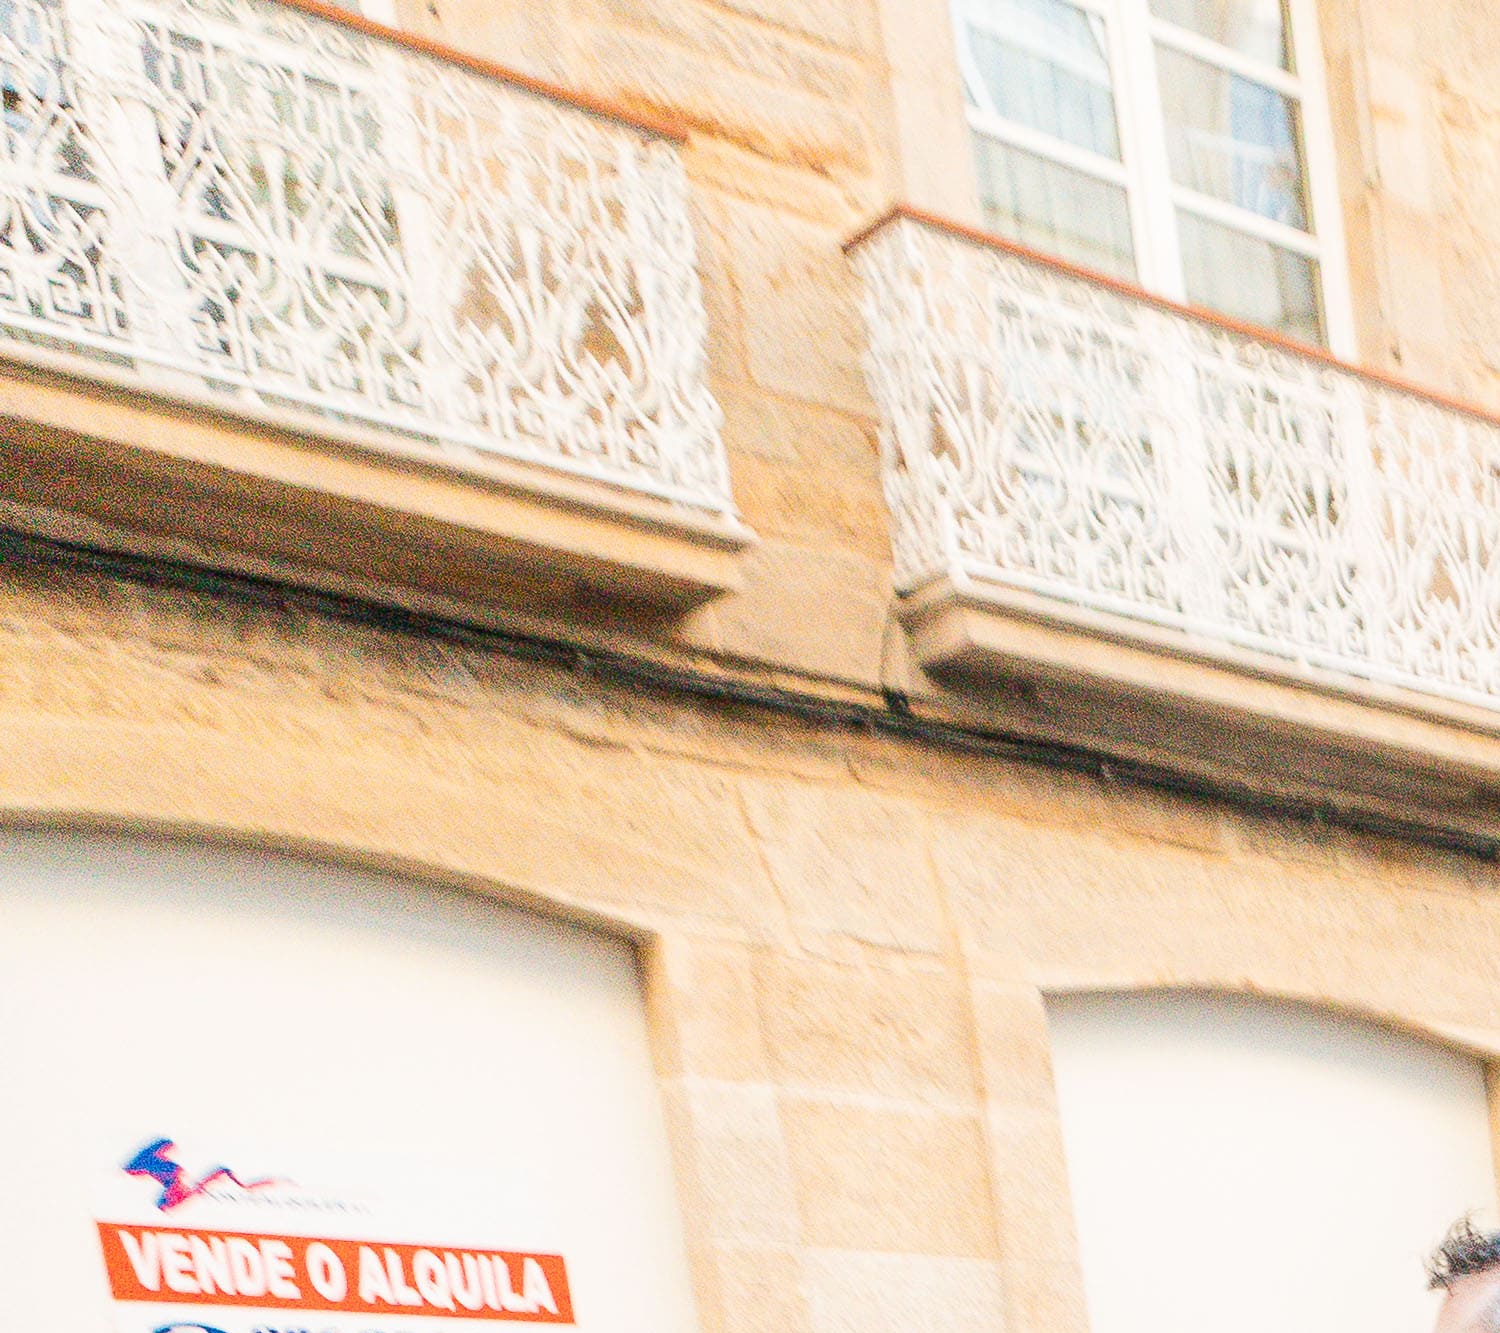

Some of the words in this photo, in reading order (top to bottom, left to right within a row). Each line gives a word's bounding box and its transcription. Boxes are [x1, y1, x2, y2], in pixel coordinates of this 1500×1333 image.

[118, 1230, 302, 1300] VENDE
[306, 1242, 349, 1302] O
[357, 1246, 559, 1315] ALQUILA
